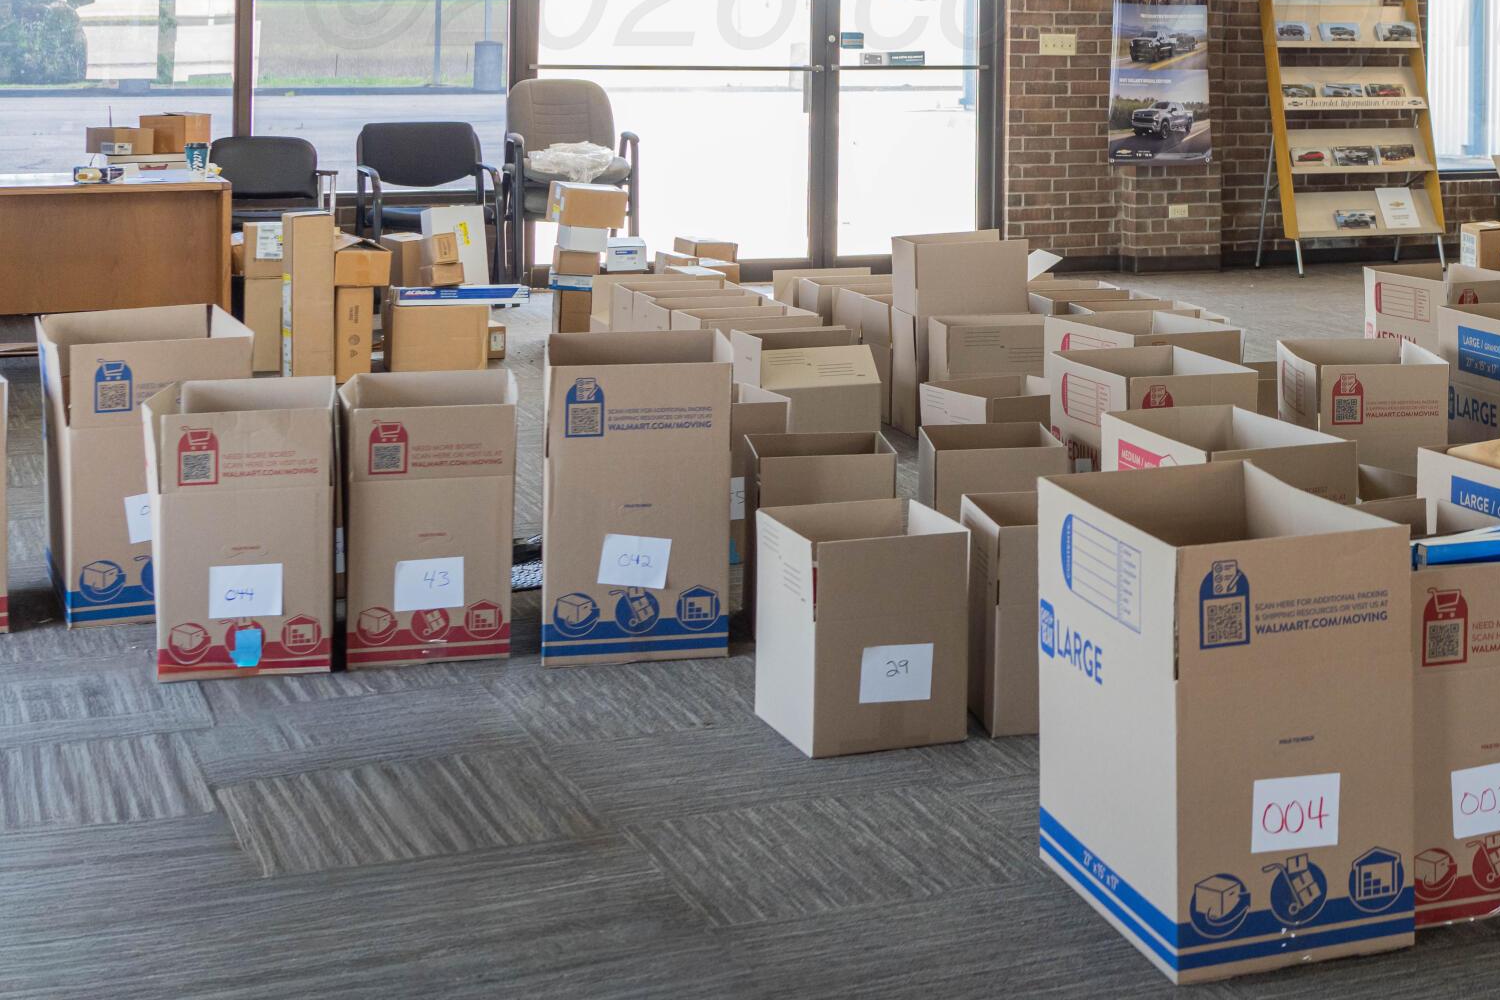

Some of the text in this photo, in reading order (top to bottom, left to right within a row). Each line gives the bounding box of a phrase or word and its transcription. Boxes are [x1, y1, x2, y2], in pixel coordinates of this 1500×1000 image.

[1305, 99, 1338, 107] Chevrolet
[1340, 99, 1381, 108] Information
[1463, 335, 1480, 349] LARGE
[1366, 410, 1440, 418] WALMART.COM/MOVING
[1456, 395, 1497, 428] LARGE
[608, 421, 712, 430] WALMART.COM/MOVING
[412, 458, 503, 467] WALMART.COM/MOVING
[222, 467, 319, 477] WALMART.COM/MOVING
[1459, 490, 1490, 513] LARGE
[617, 553, 652, 568] 042
[423, 570, 450, 589] 43
[1255, 590, 1388, 611] SCAN HERE FOR ADDITIONAL PACKING
[1254, 611, 1388, 634] WALMART.COM/MOVING
[1472, 621, 1494, 630] NEED
[1472, 632, 1494, 641] SCAN
[1056, 619, 1103, 685] LARGE
[886, 659, 909, 677] 29
[1263, 796, 1330, 834] 004
